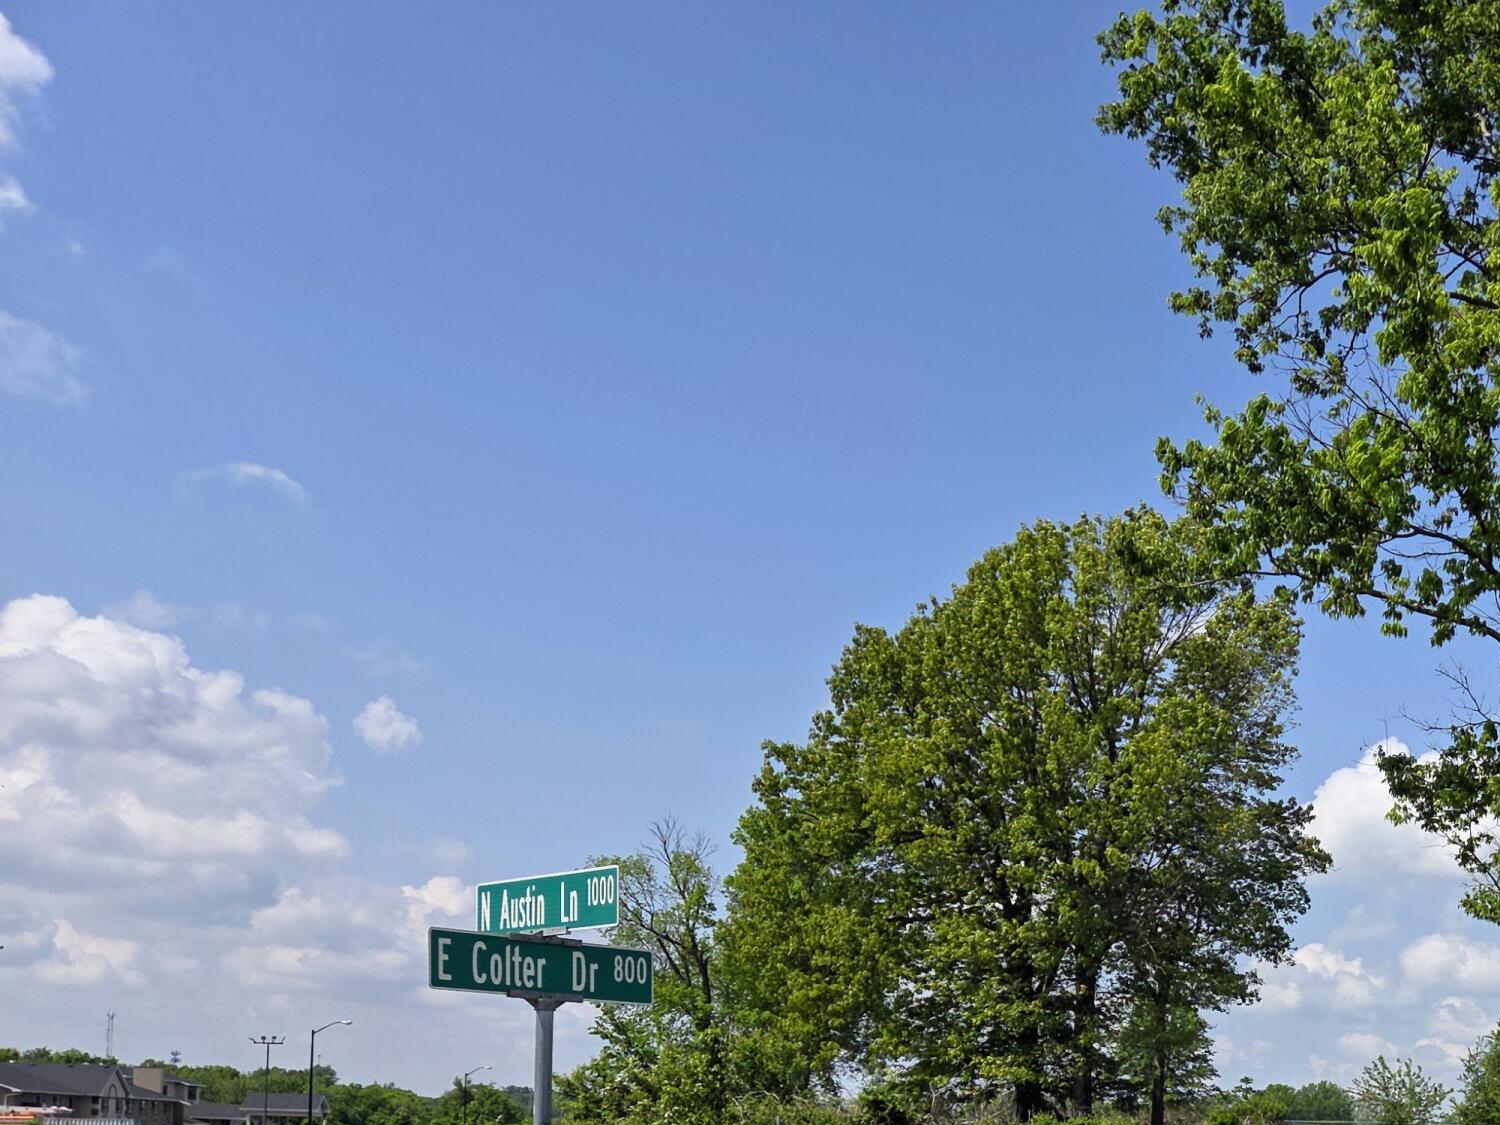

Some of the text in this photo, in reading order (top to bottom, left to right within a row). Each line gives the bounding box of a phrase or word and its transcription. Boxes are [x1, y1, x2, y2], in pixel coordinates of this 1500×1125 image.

[481, 875, 614, 931] N Austin Ln 1000
[437, 937, 647, 992] E Colter Dr 800
